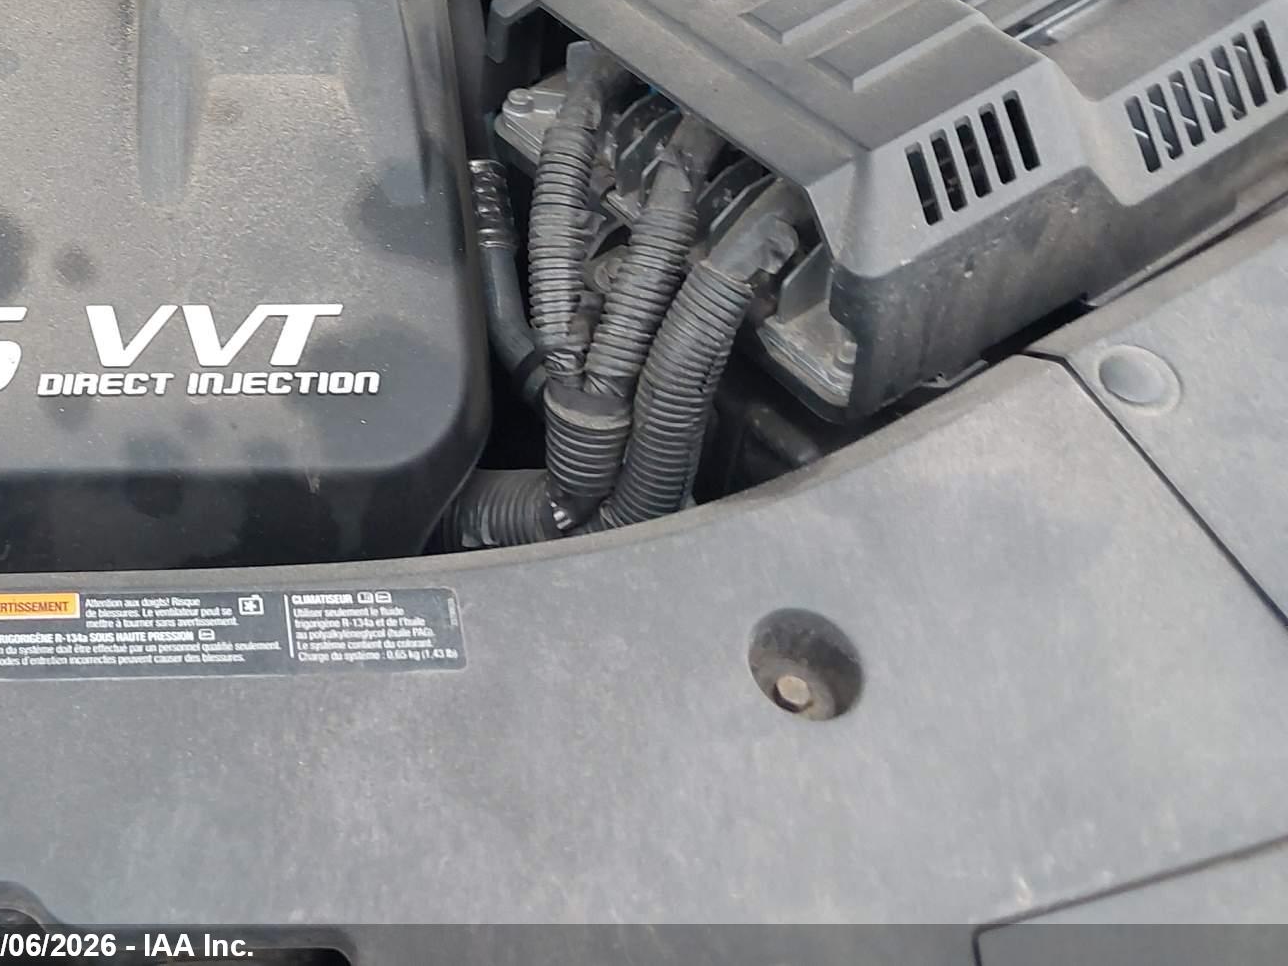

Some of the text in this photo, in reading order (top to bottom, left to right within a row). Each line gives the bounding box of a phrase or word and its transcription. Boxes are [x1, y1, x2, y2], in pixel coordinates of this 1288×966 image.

[85, 304, 343, 367] VVT
[37, 371, 380, 396] DIRECT INJECTION
[292, 594, 353, 604] CLIMATISEUR
[54, 633, 89, 642] R-134a
[89, 633, 115, 642] SOUS
[115, 632, 147, 641] HAUTE
[147, 632, 194, 641] PRESSION
